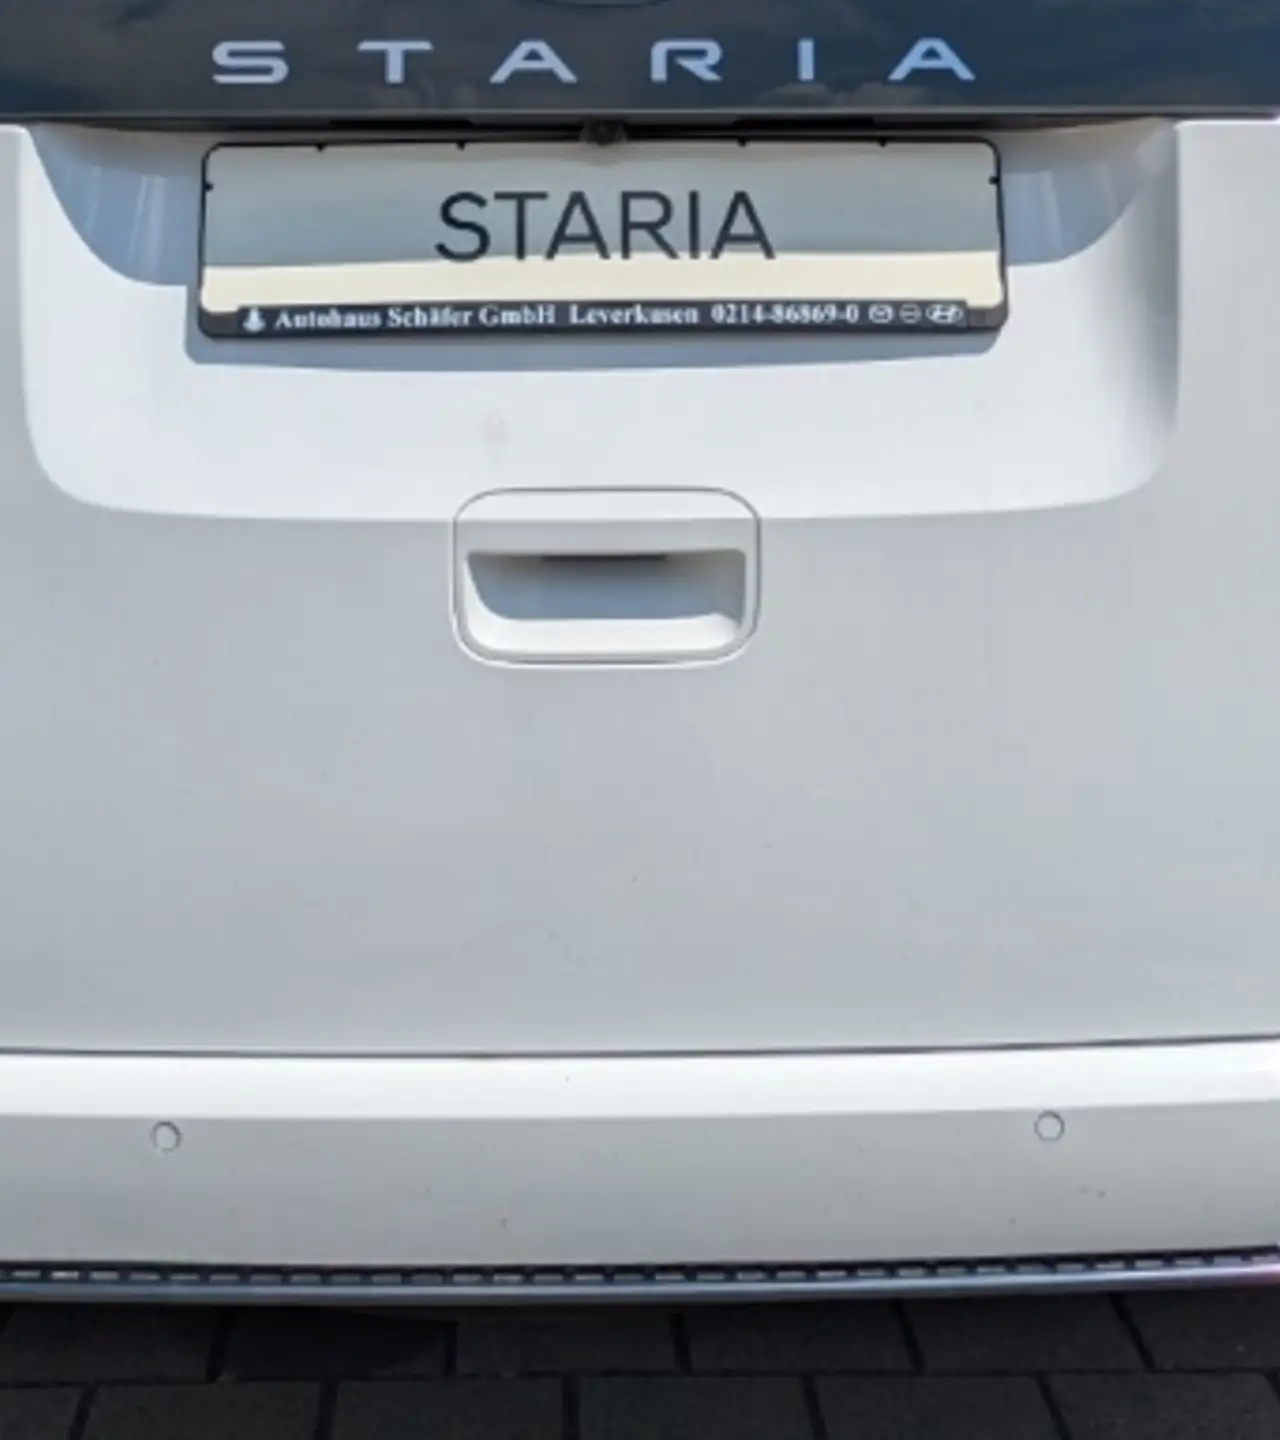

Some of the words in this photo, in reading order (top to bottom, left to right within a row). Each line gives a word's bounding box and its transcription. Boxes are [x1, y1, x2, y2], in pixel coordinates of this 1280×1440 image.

[211, 36, 977, 86] STARIA
[434, 189, 776, 262] STARIA
[273, 307, 382, 330] Autohaus
[386, 304, 472, 329] Schäfer
[478, 303, 556, 327] GmbH
[570, 303, 700, 325] Leverkusen
[711, 302, 860, 325] 0214-86869-0
